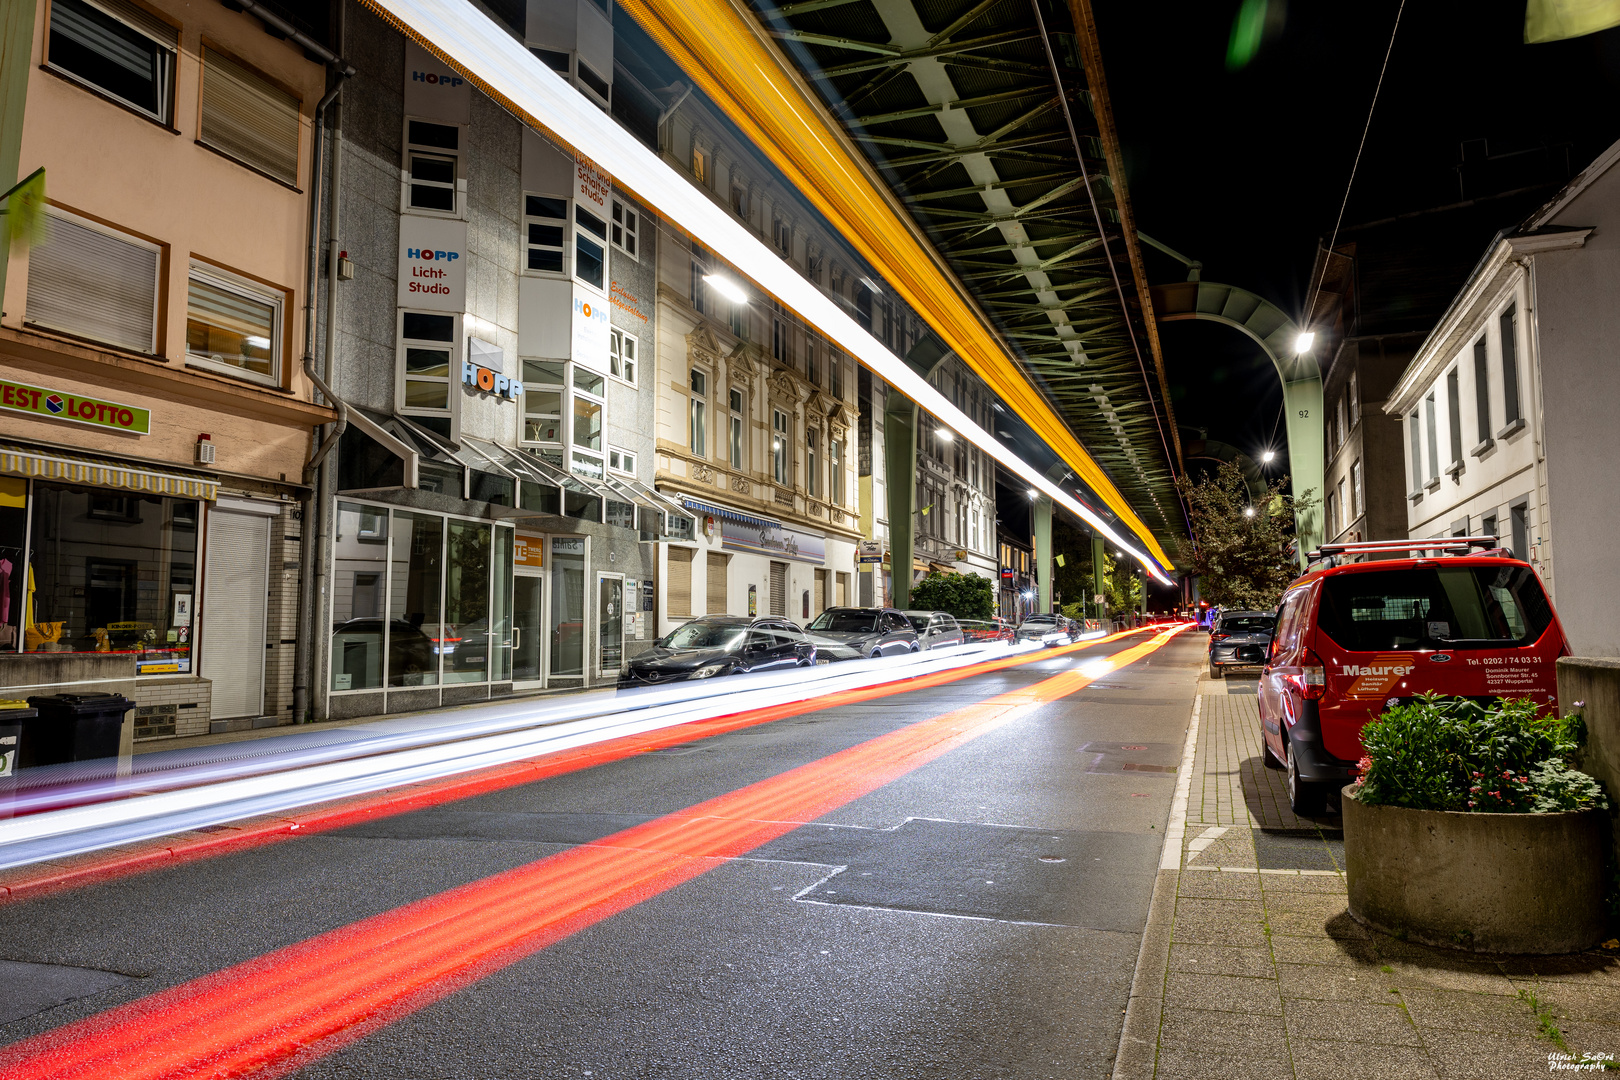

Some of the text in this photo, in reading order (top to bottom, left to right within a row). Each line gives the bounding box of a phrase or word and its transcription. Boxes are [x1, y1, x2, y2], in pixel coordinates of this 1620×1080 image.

[412, 70, 464, 88] HOPP
[577, 167, 609, 198] Schalter
[580, 183, 604, 207] studio
[407, 247, 460, 262] HOPP
[412, 265, 448, 279] Licht-
[408, 281, 451, 295] Studio
[610, 281, 638, 304] Exclusive
[574, 297, 608, 324] HOPP
[607, 294, 648, 325] ichtgestaltung
[461, 360, 524, 400] HOPP
[0, 383, 134, 427] EST LOTTO
[1298, 409, 1309, 419] 92
[1342, 664, 1416, 676] Maurer
[1466, 658, 1482, 666] Tel.
[1482, 657, 1503, 665] 0202
[1509, 656, 1519, 664] 74
[1520, 656, 1531, 664] 03
[1532, 656, 1542, 664] 31
